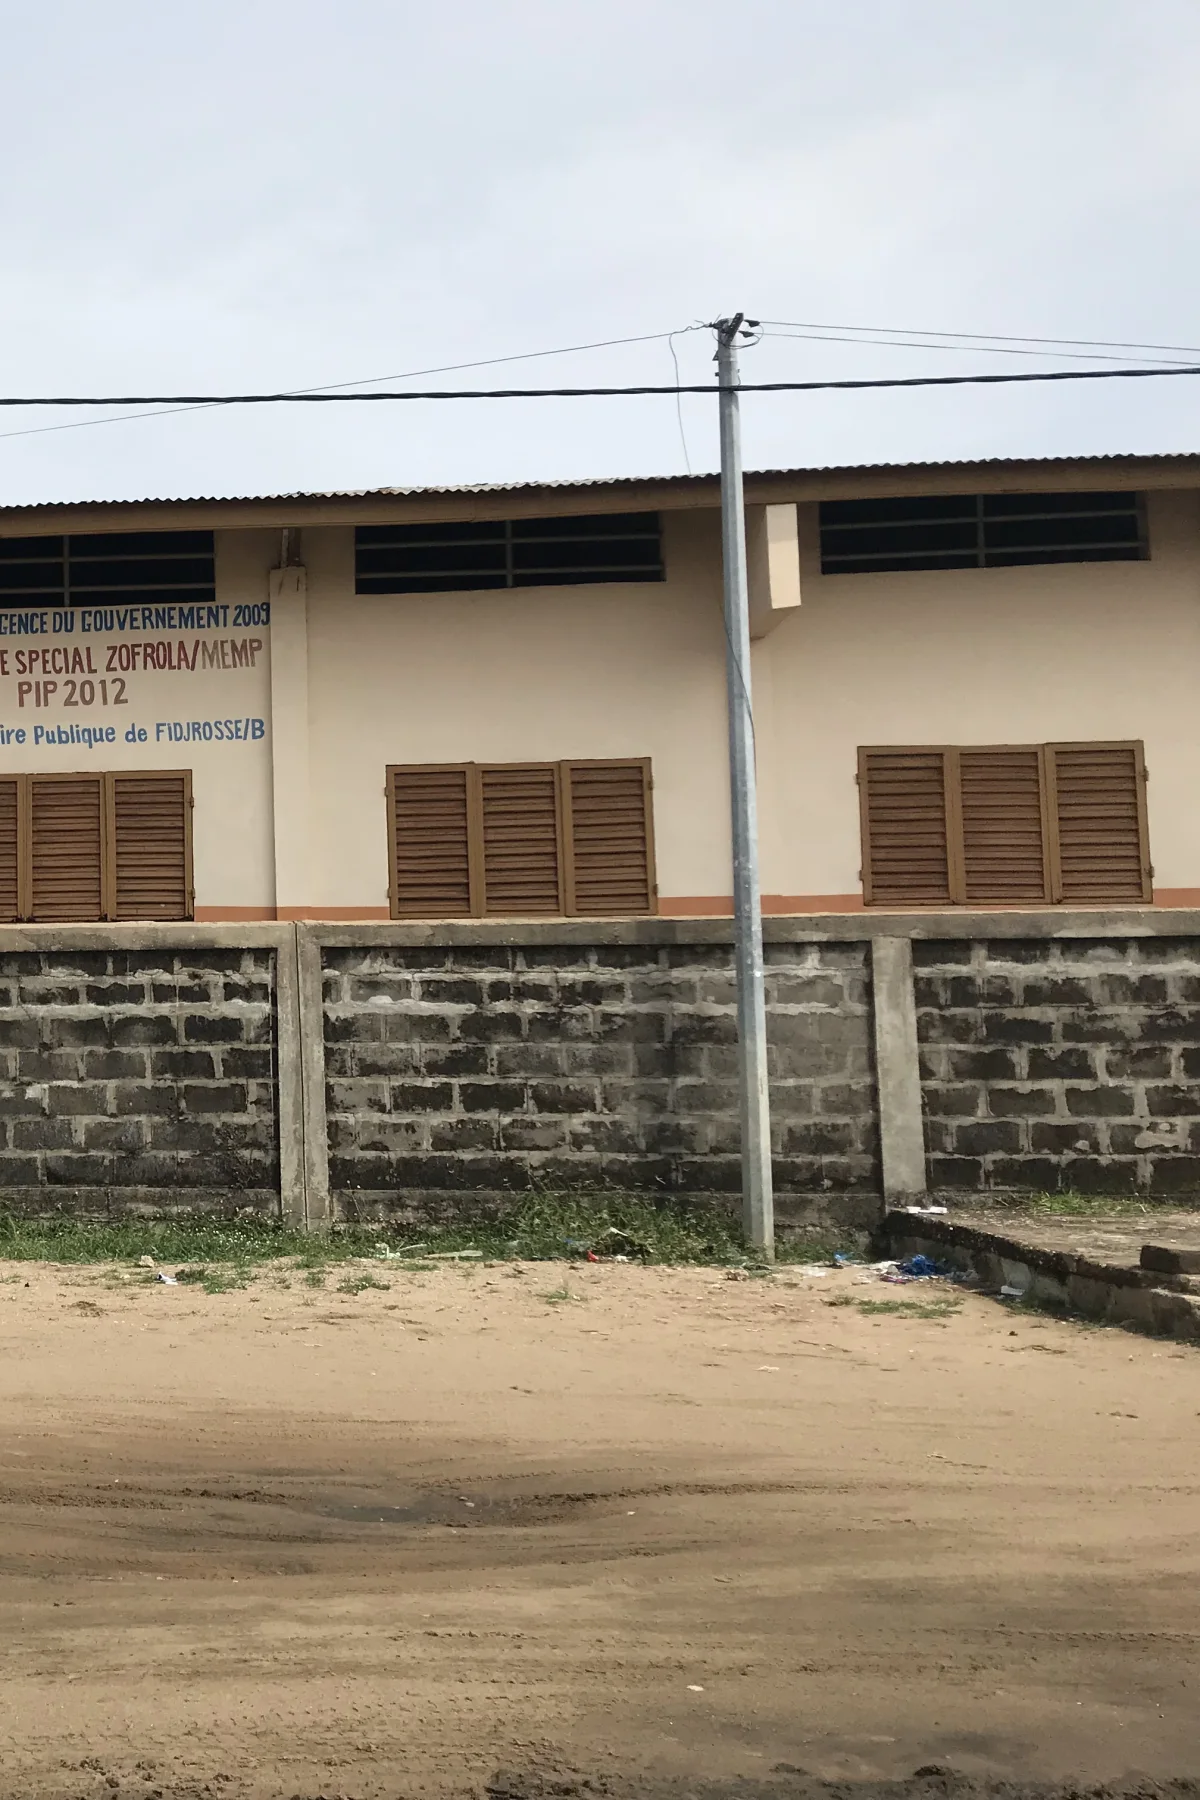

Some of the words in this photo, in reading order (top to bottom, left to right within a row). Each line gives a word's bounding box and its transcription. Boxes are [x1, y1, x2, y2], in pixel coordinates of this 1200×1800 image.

[52, 611, 75, 634] DU
[81, 605, 230, 632] GOUVERNEMENT
[233, 602, 270, 627] 2009
[15, 646, 97, 675] SPECIAL
[18, 680, 58, 708] PIP
[63, 677, 129, 706] 2012
[33, 724, 116, 749] Publique
[125, 722, 148, 743] de
